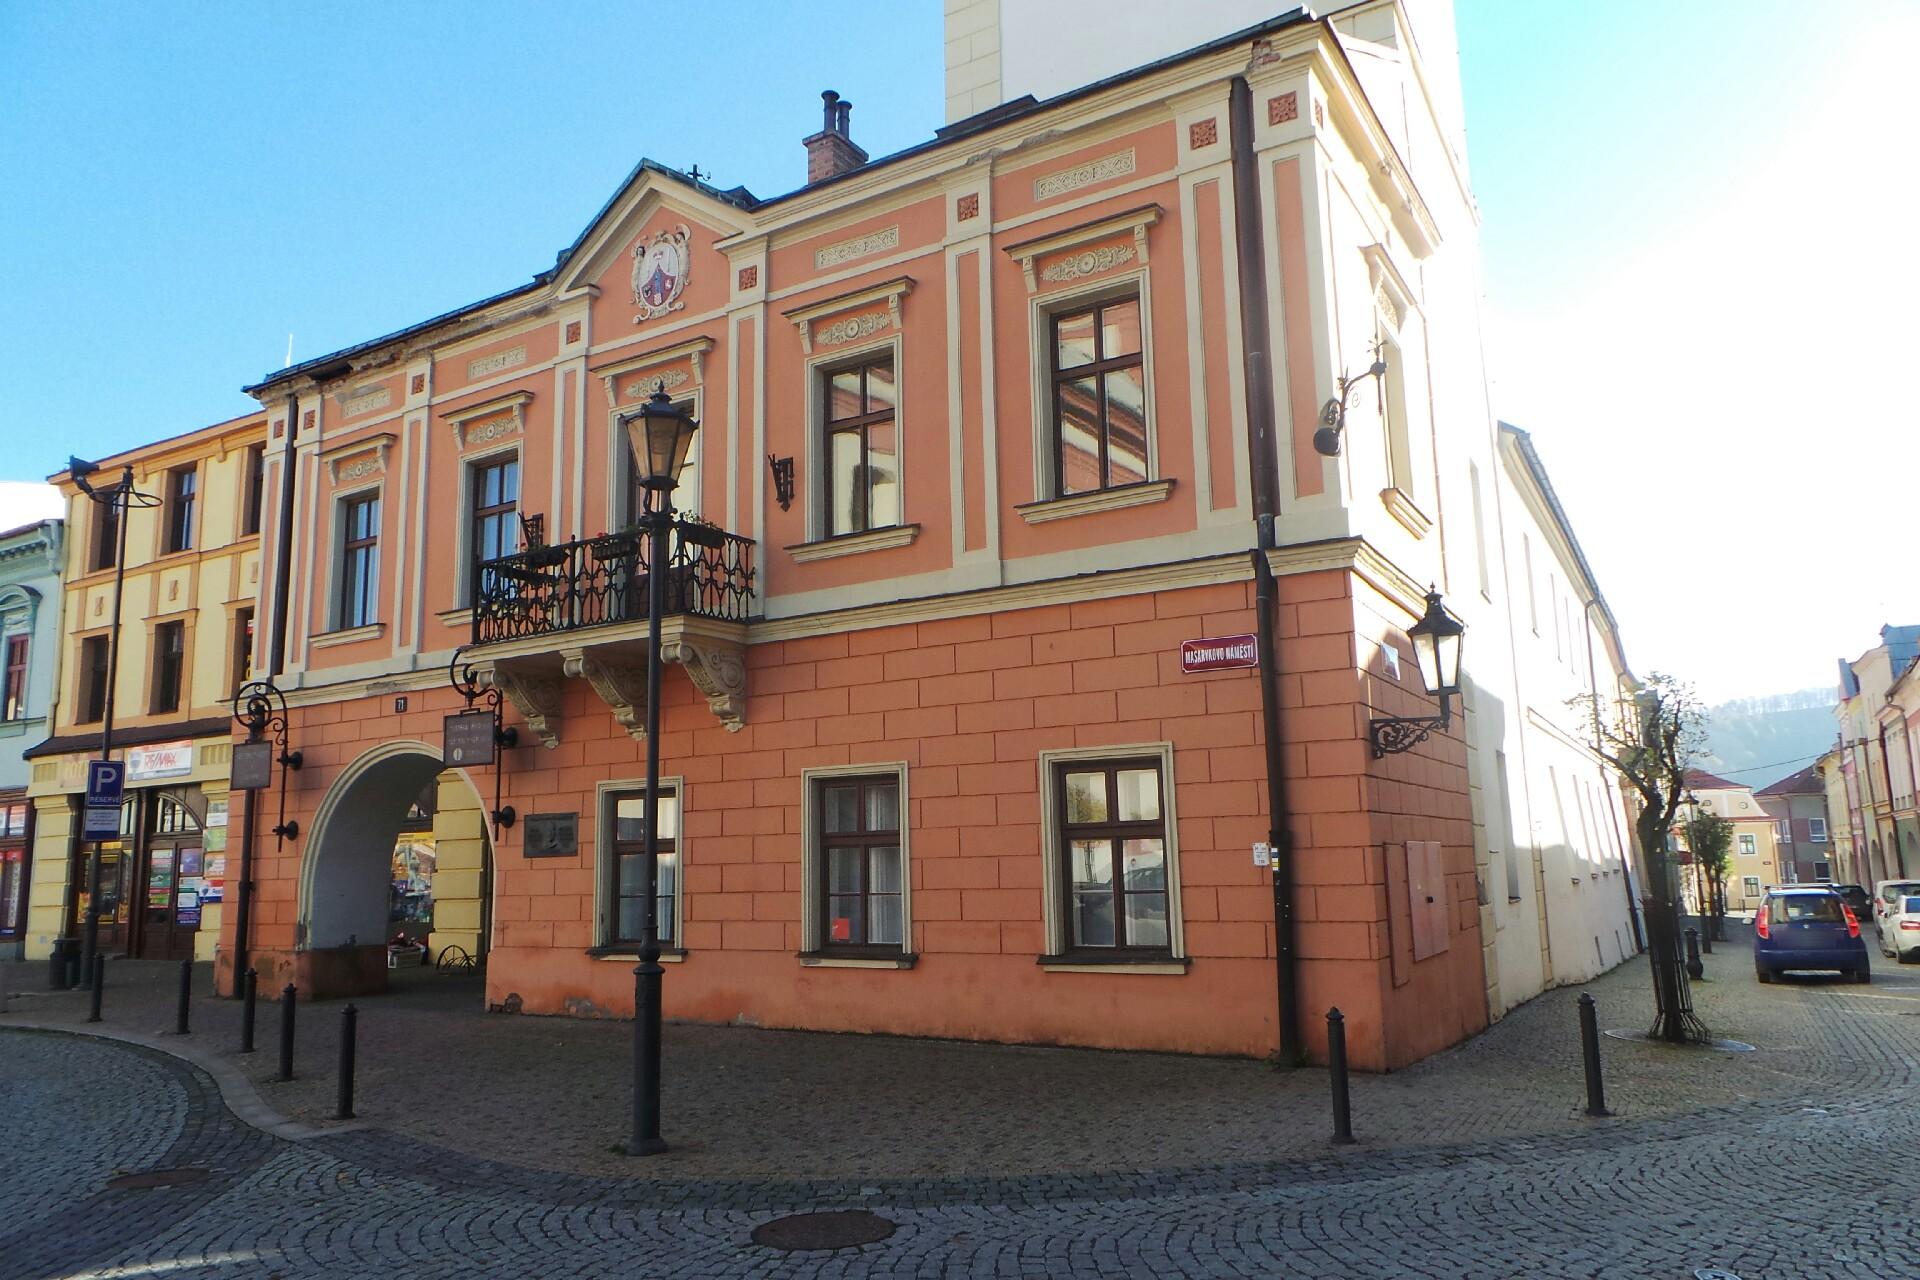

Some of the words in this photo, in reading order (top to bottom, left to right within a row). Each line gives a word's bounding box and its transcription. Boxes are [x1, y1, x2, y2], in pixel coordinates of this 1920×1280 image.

[1185, 648, 1225, 664] MASARYKOVO
[1225, 643, 1254, 660] NÁMĚSTÍ
[145, 752, 176, 769] RE/MAX
[96, 767, 117, 793] P
